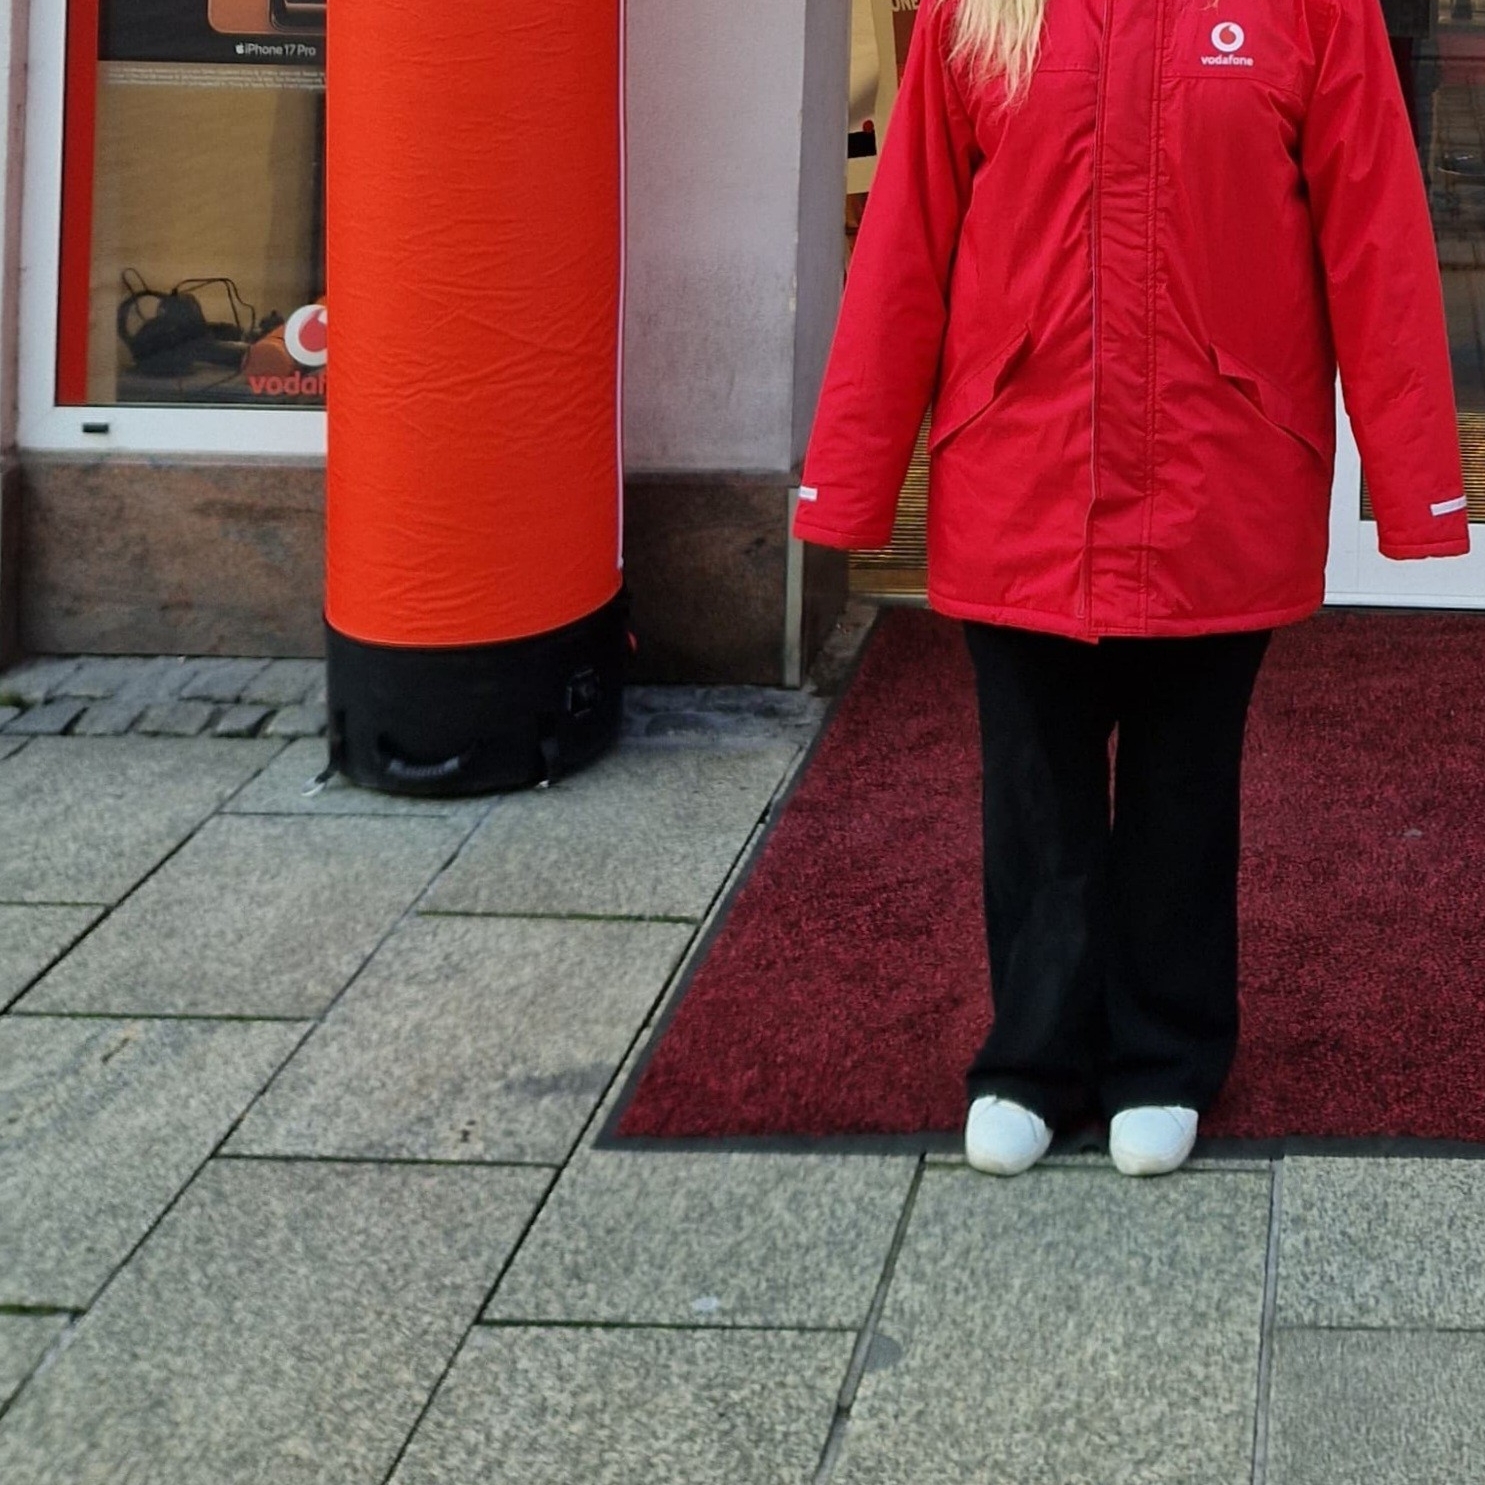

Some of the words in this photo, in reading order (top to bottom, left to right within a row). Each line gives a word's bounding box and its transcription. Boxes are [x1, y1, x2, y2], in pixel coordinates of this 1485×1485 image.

[245, 43, 283, 56] iPhone
[284, 44, 296, 56] 17
[297, 44, 316, 57] Pro
[1200, 54, 1254, 67] vodafone
